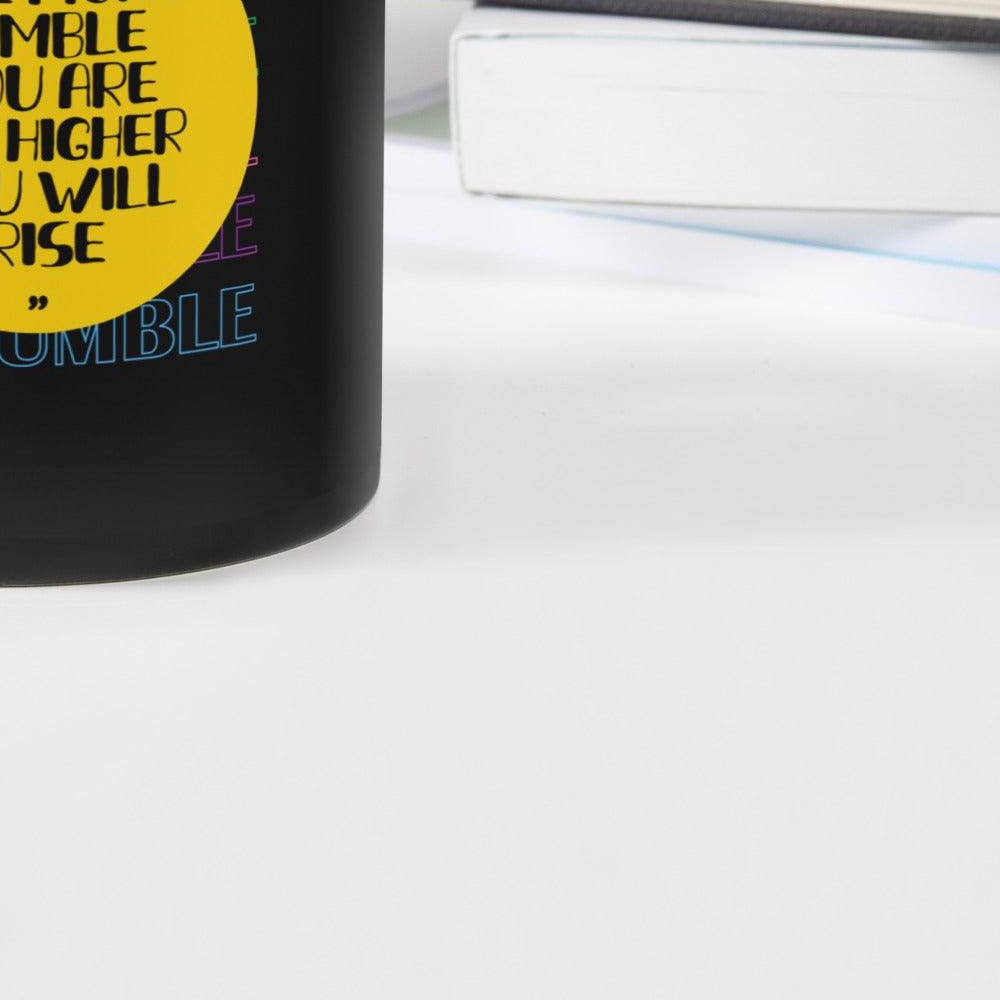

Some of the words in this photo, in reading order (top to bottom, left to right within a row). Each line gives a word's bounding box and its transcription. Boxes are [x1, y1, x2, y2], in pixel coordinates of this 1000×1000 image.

[58, 60, 159, 110] ARE
[6, 107, 188, 163] HIGHER
[37, 162, 177, 214] WILL
